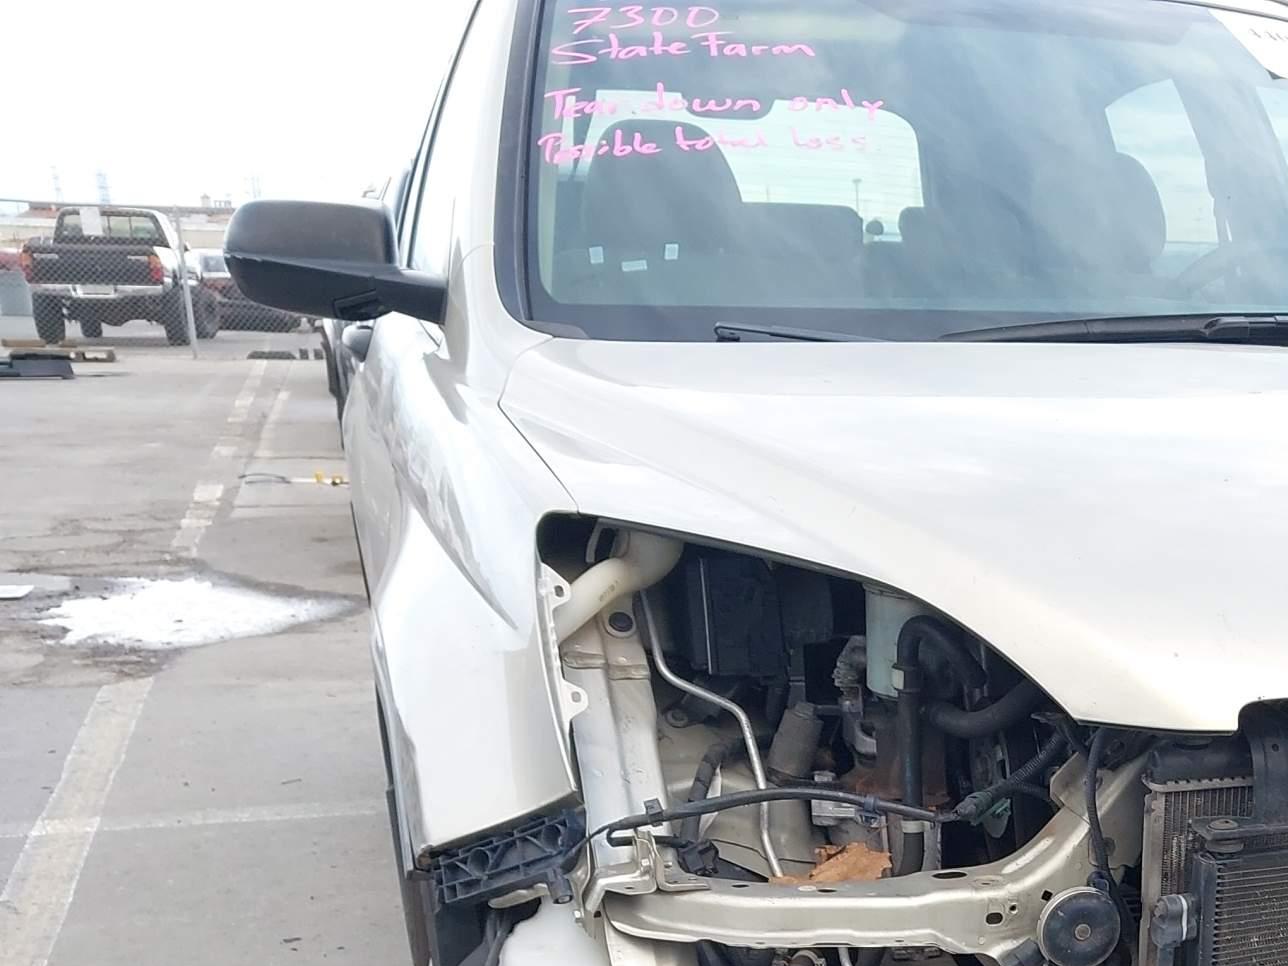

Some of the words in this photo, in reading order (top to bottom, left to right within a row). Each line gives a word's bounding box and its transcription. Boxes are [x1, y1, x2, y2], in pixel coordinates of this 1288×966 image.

[568, 4, 720, 34] 7300
[551, 33, 691, 65] State
[690, 31, 816, 57] Farm
[788, 89, 884, 122] only
[792, 129, 871, 151] loss
